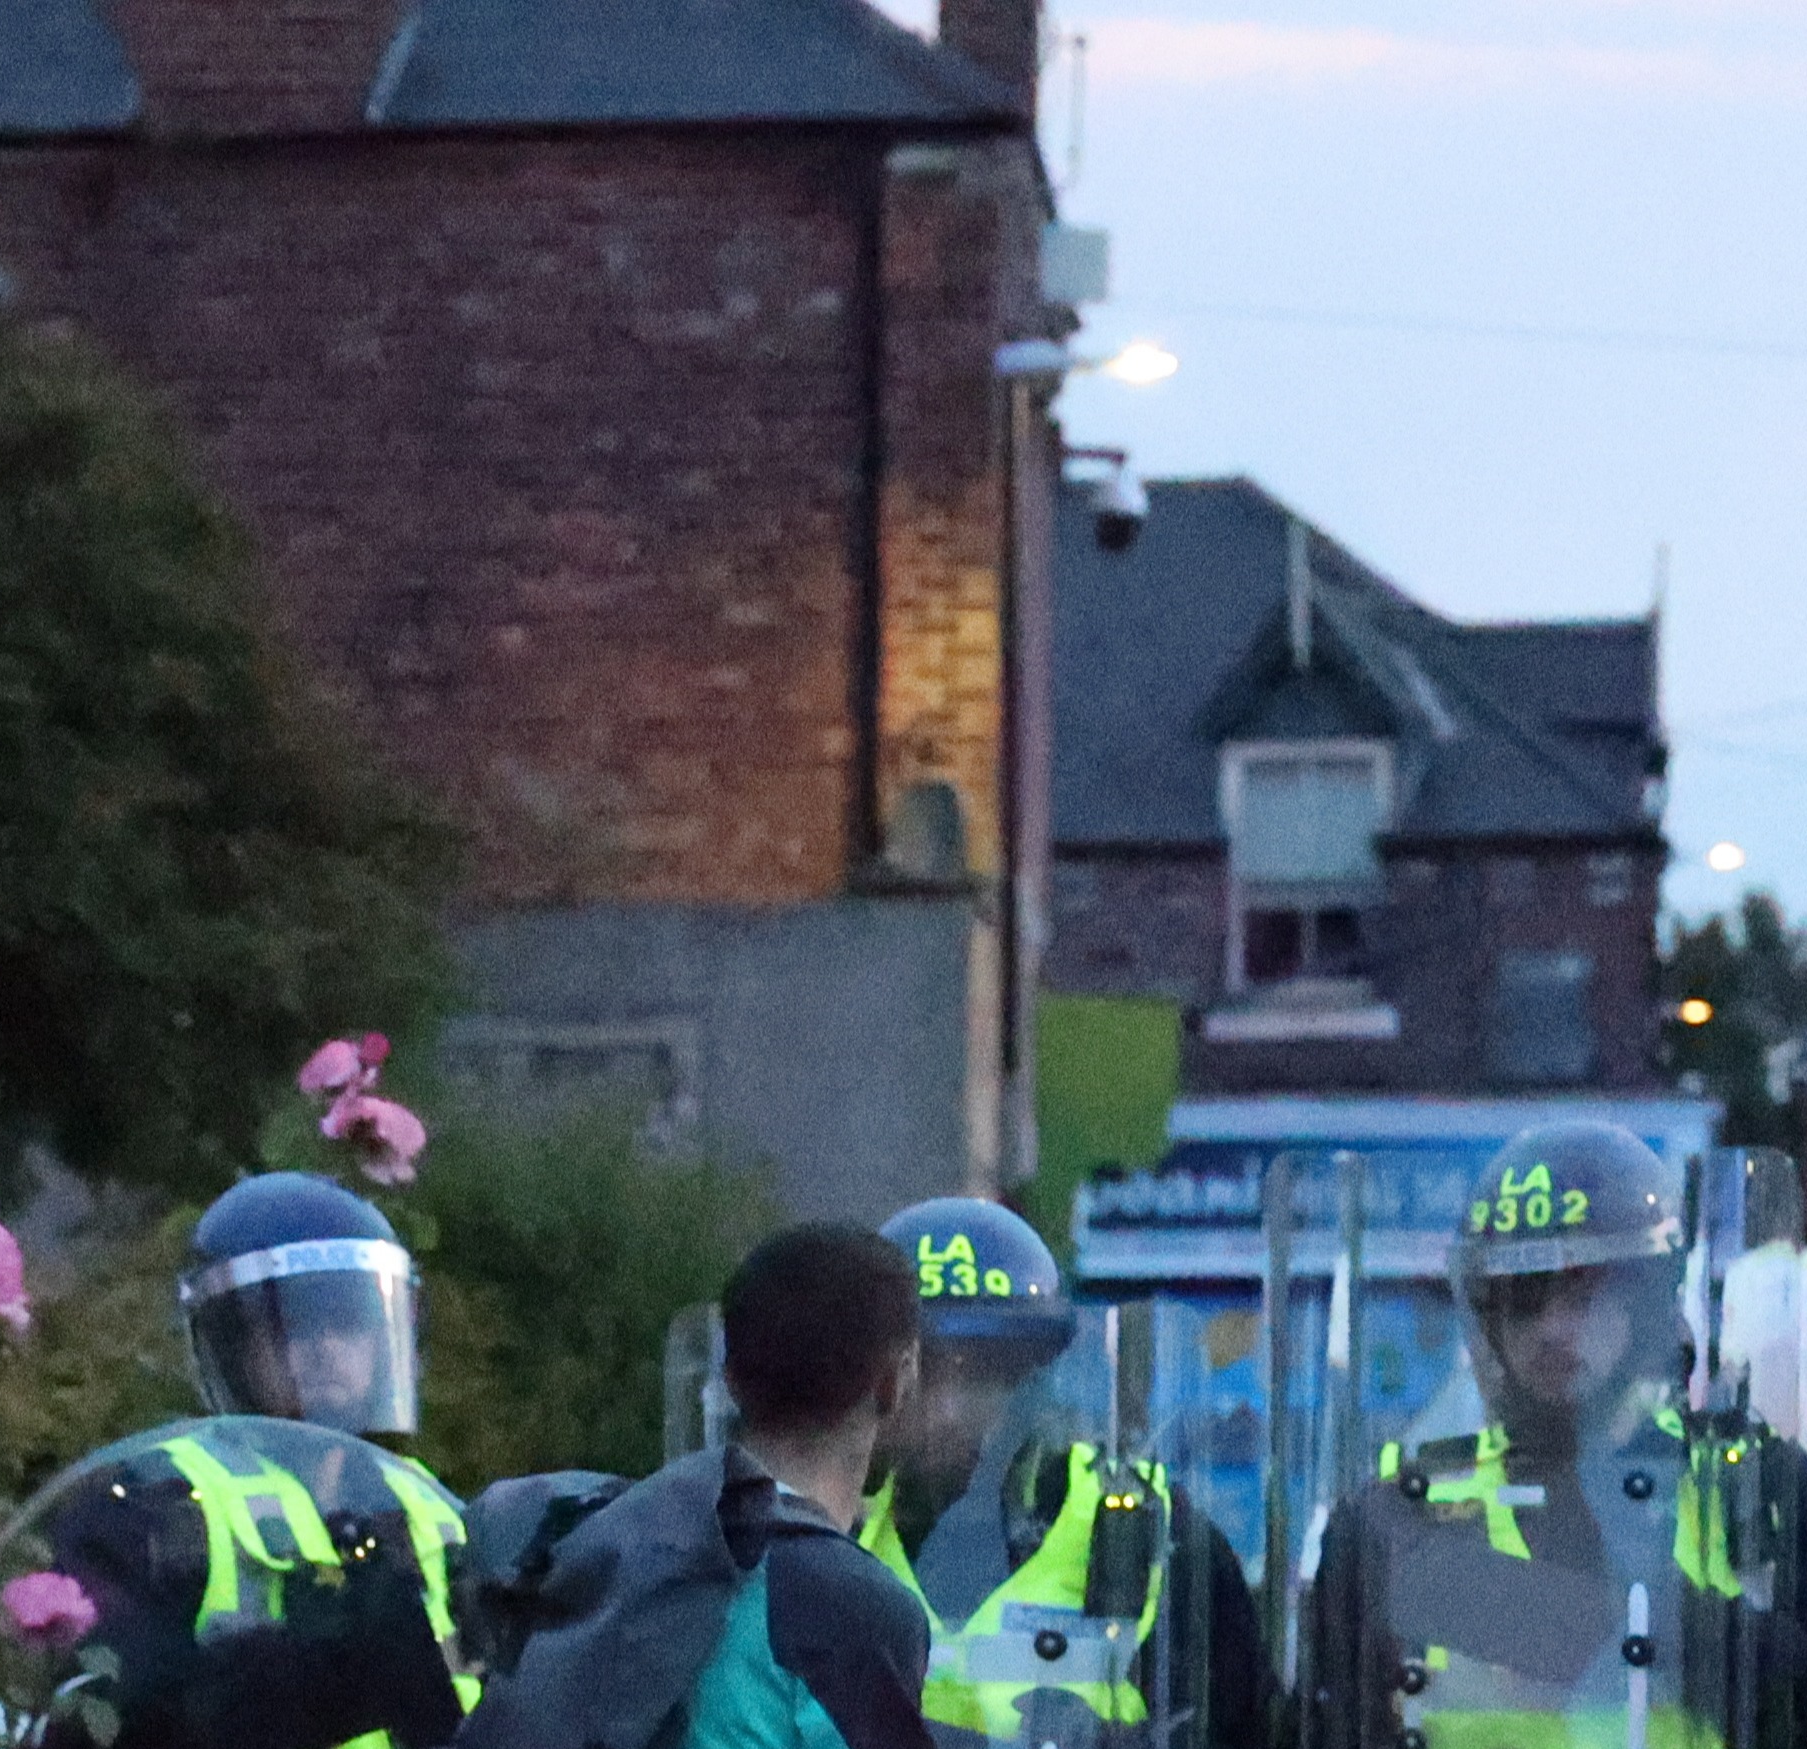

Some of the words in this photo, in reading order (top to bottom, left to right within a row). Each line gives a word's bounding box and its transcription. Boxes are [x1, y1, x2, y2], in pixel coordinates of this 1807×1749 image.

[1500, 1164, 1551, 1196] LA
[1470, 1190, 1589, 1233] 9302
[918, 1233, 975, 1264] LA
